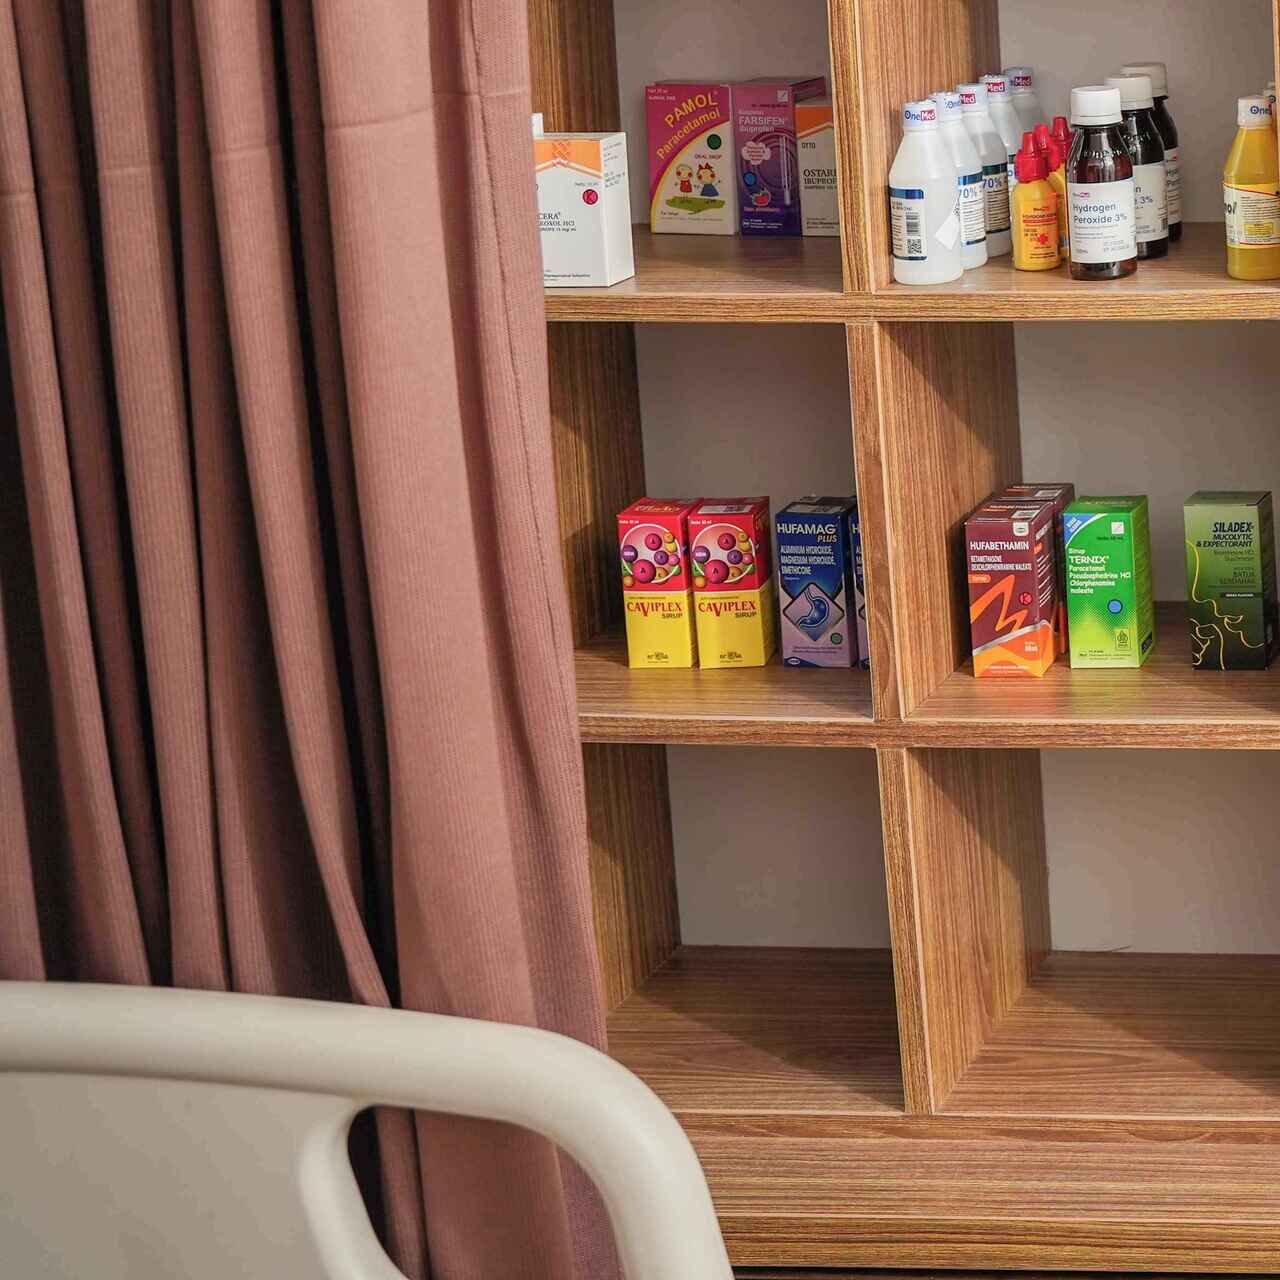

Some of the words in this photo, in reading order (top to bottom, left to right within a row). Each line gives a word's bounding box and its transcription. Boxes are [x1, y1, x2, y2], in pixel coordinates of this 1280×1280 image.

[665, 94, 718, 128] PAMOL
[905, 109, 936, 121] OneMed
[739, 116, 784, 125] FARSIFEN
[656, 108, 721, 160] Paracetamol
[983, 178, 1002, 188] 70%
[1073, 204, 1116, 213] Hydrogen
[1074, 215, 1112, 225] Peroxide
[777, 523, 836, 534] HUFAMAG
[1213, 522, 1252, 532] SILADEX
[817, 535, 838, 543] PLUS
[970, 541, 1029, 551] HUFABETHAMIN
[1069, 556, 1106, 564] TERNIX
[627, 601, 682, 617] CAVIPLEX
[698, 601, 756, 617] CAVIPLEX
